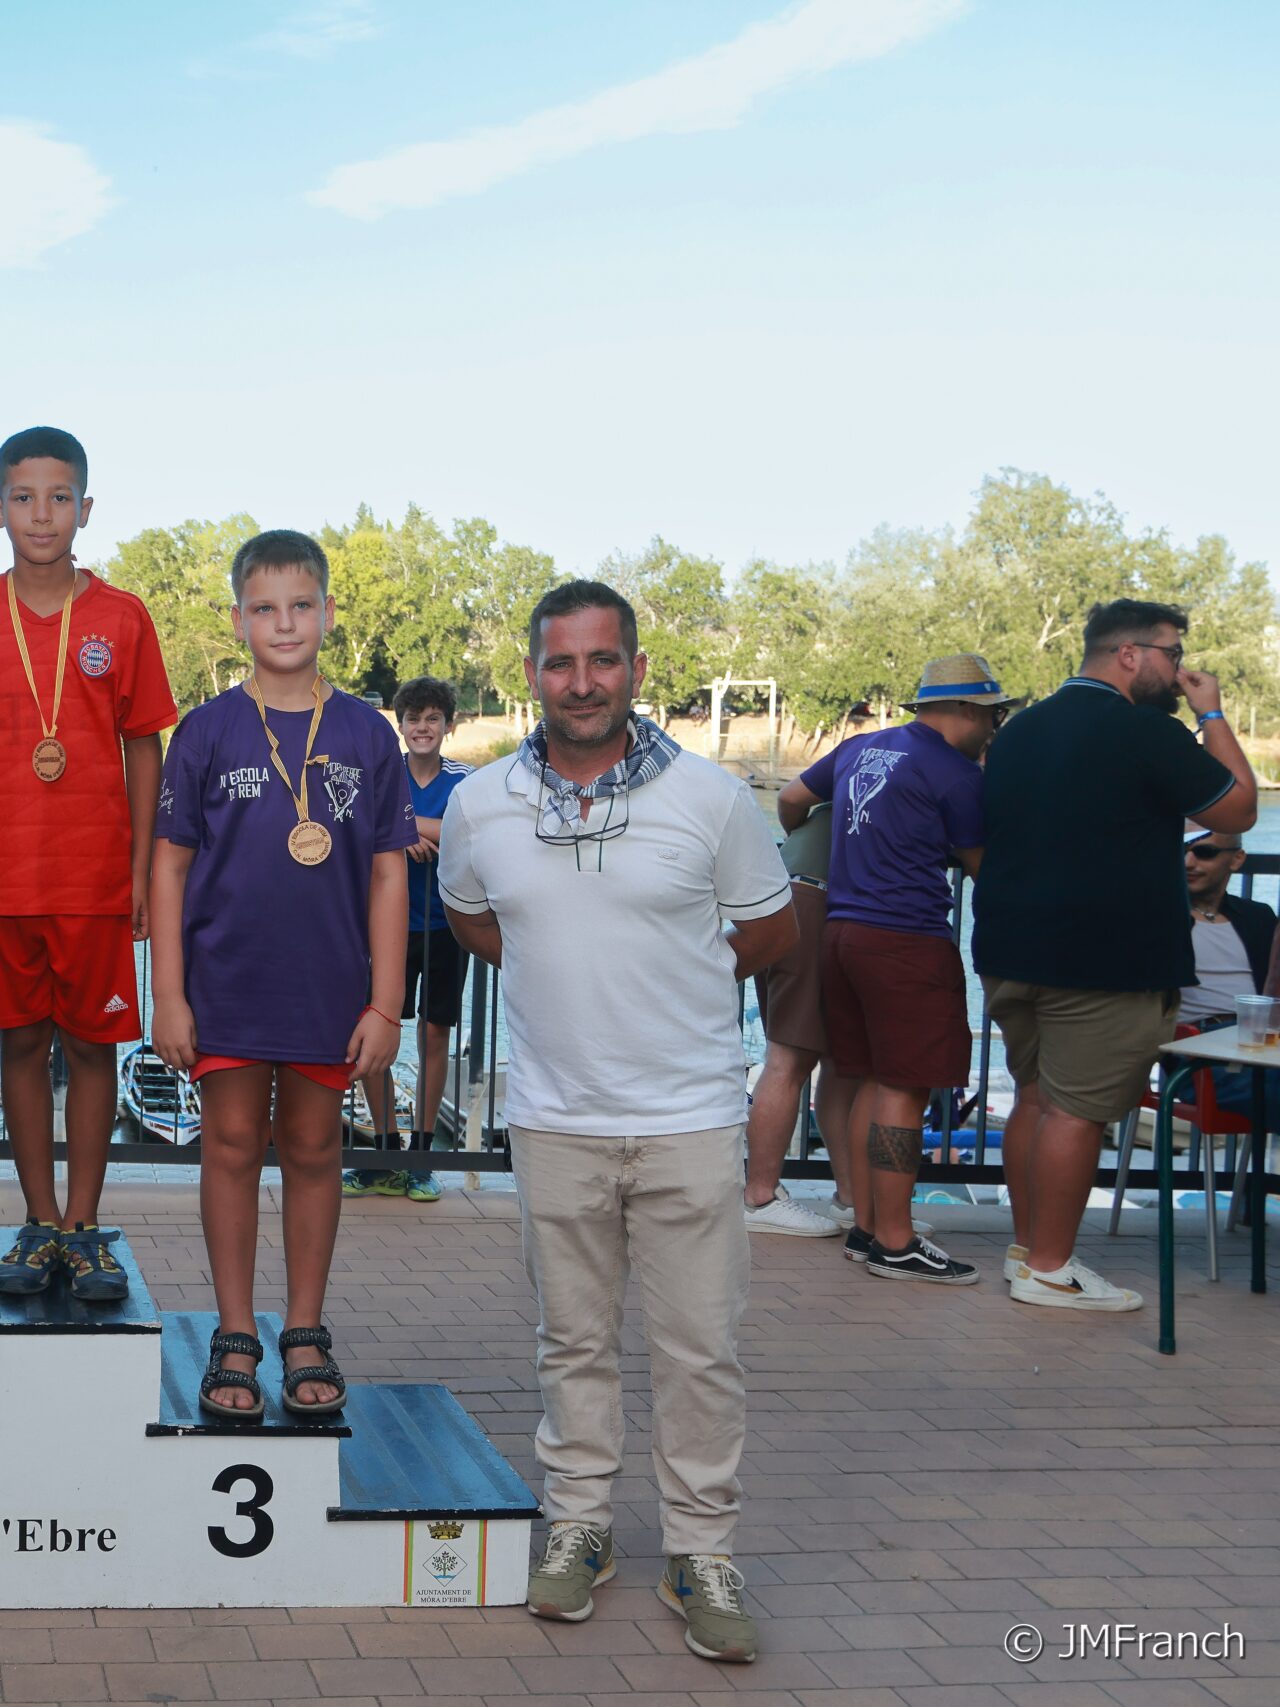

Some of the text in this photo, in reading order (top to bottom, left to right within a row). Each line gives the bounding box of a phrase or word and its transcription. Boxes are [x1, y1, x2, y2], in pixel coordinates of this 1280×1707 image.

[229, 767, 269, 786] ESCOLA
[237, 783, 261, 798] REM
[104, 1003, 128, 1013] adidas
[207, 1464, 274, 1558] 3
